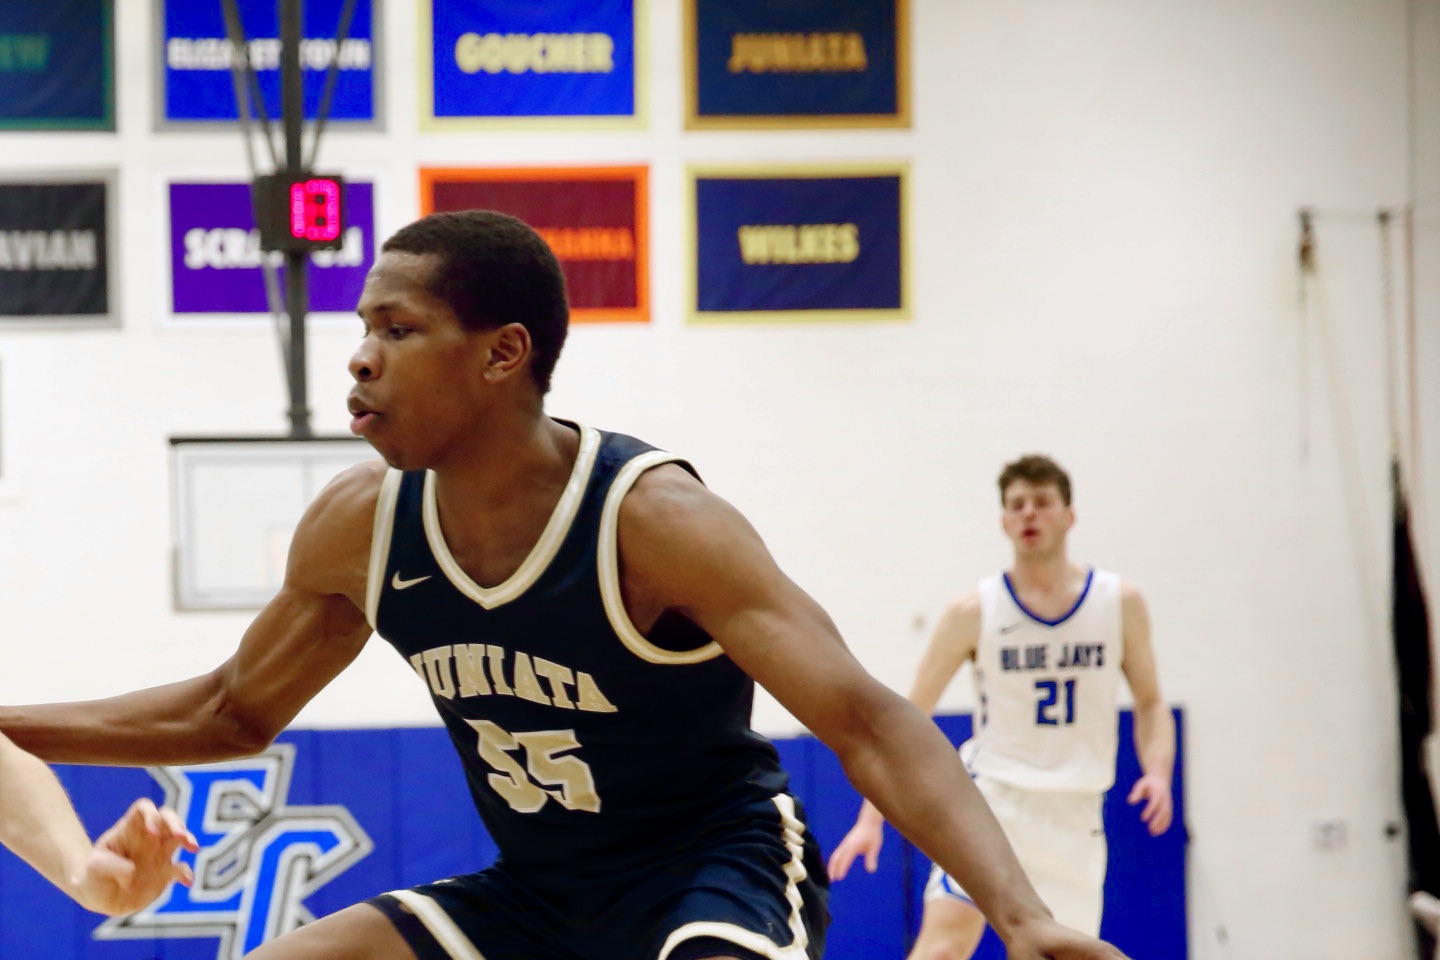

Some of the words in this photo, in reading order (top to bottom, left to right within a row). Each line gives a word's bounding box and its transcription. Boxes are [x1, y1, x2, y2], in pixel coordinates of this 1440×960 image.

[455, 33, 614, 74] GOUCHER
[728, 32, 867, 72] JUNIATA
[738, 222, 860, 265] WILKES
[1000, 645, 1047, 670] BLUE
[1034, 680, 1077, 725] 21
[462, 718, 601, 813] 55
